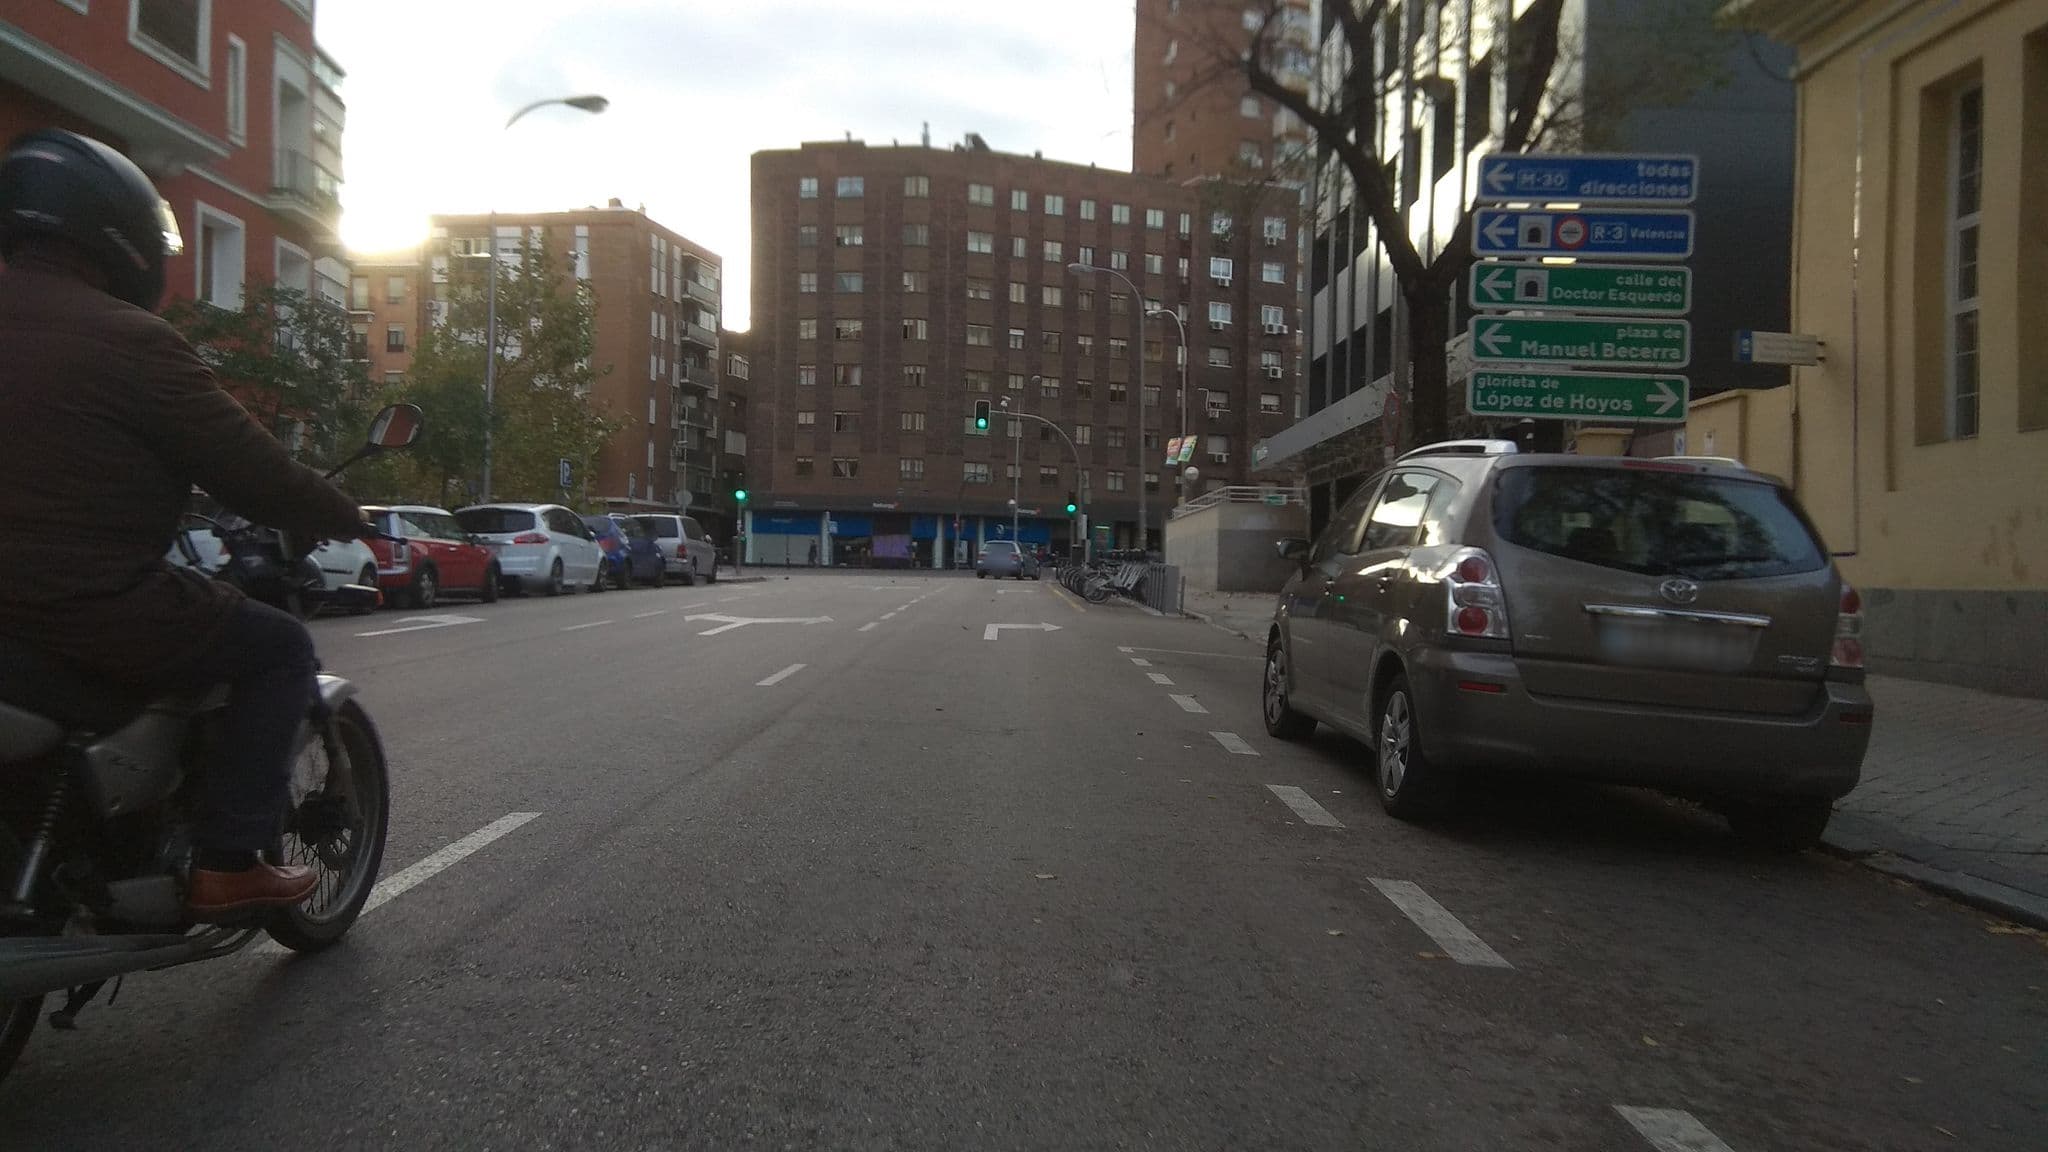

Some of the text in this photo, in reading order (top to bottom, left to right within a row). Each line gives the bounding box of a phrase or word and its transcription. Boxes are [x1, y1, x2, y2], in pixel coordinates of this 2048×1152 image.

[1637, 162, 1691, 177] todas
[1519, 173, 1566, 186] M-30
[1579, 180, 1689, 196] direcciones
[1594, 225, 1686, 240] R-3 Valencia
[1616, 273, 1682, 287] calle del
[1553, 287, 1682, 304] Doctor Esquerdo
[1616, 326, 1681, 340] plaza de
[1521, 341, 1681, 359] Manuel Becerra
[1477, 375, 1560, 390] glorieta de
[1476, 390, 1633, 413] López de Hoyos
